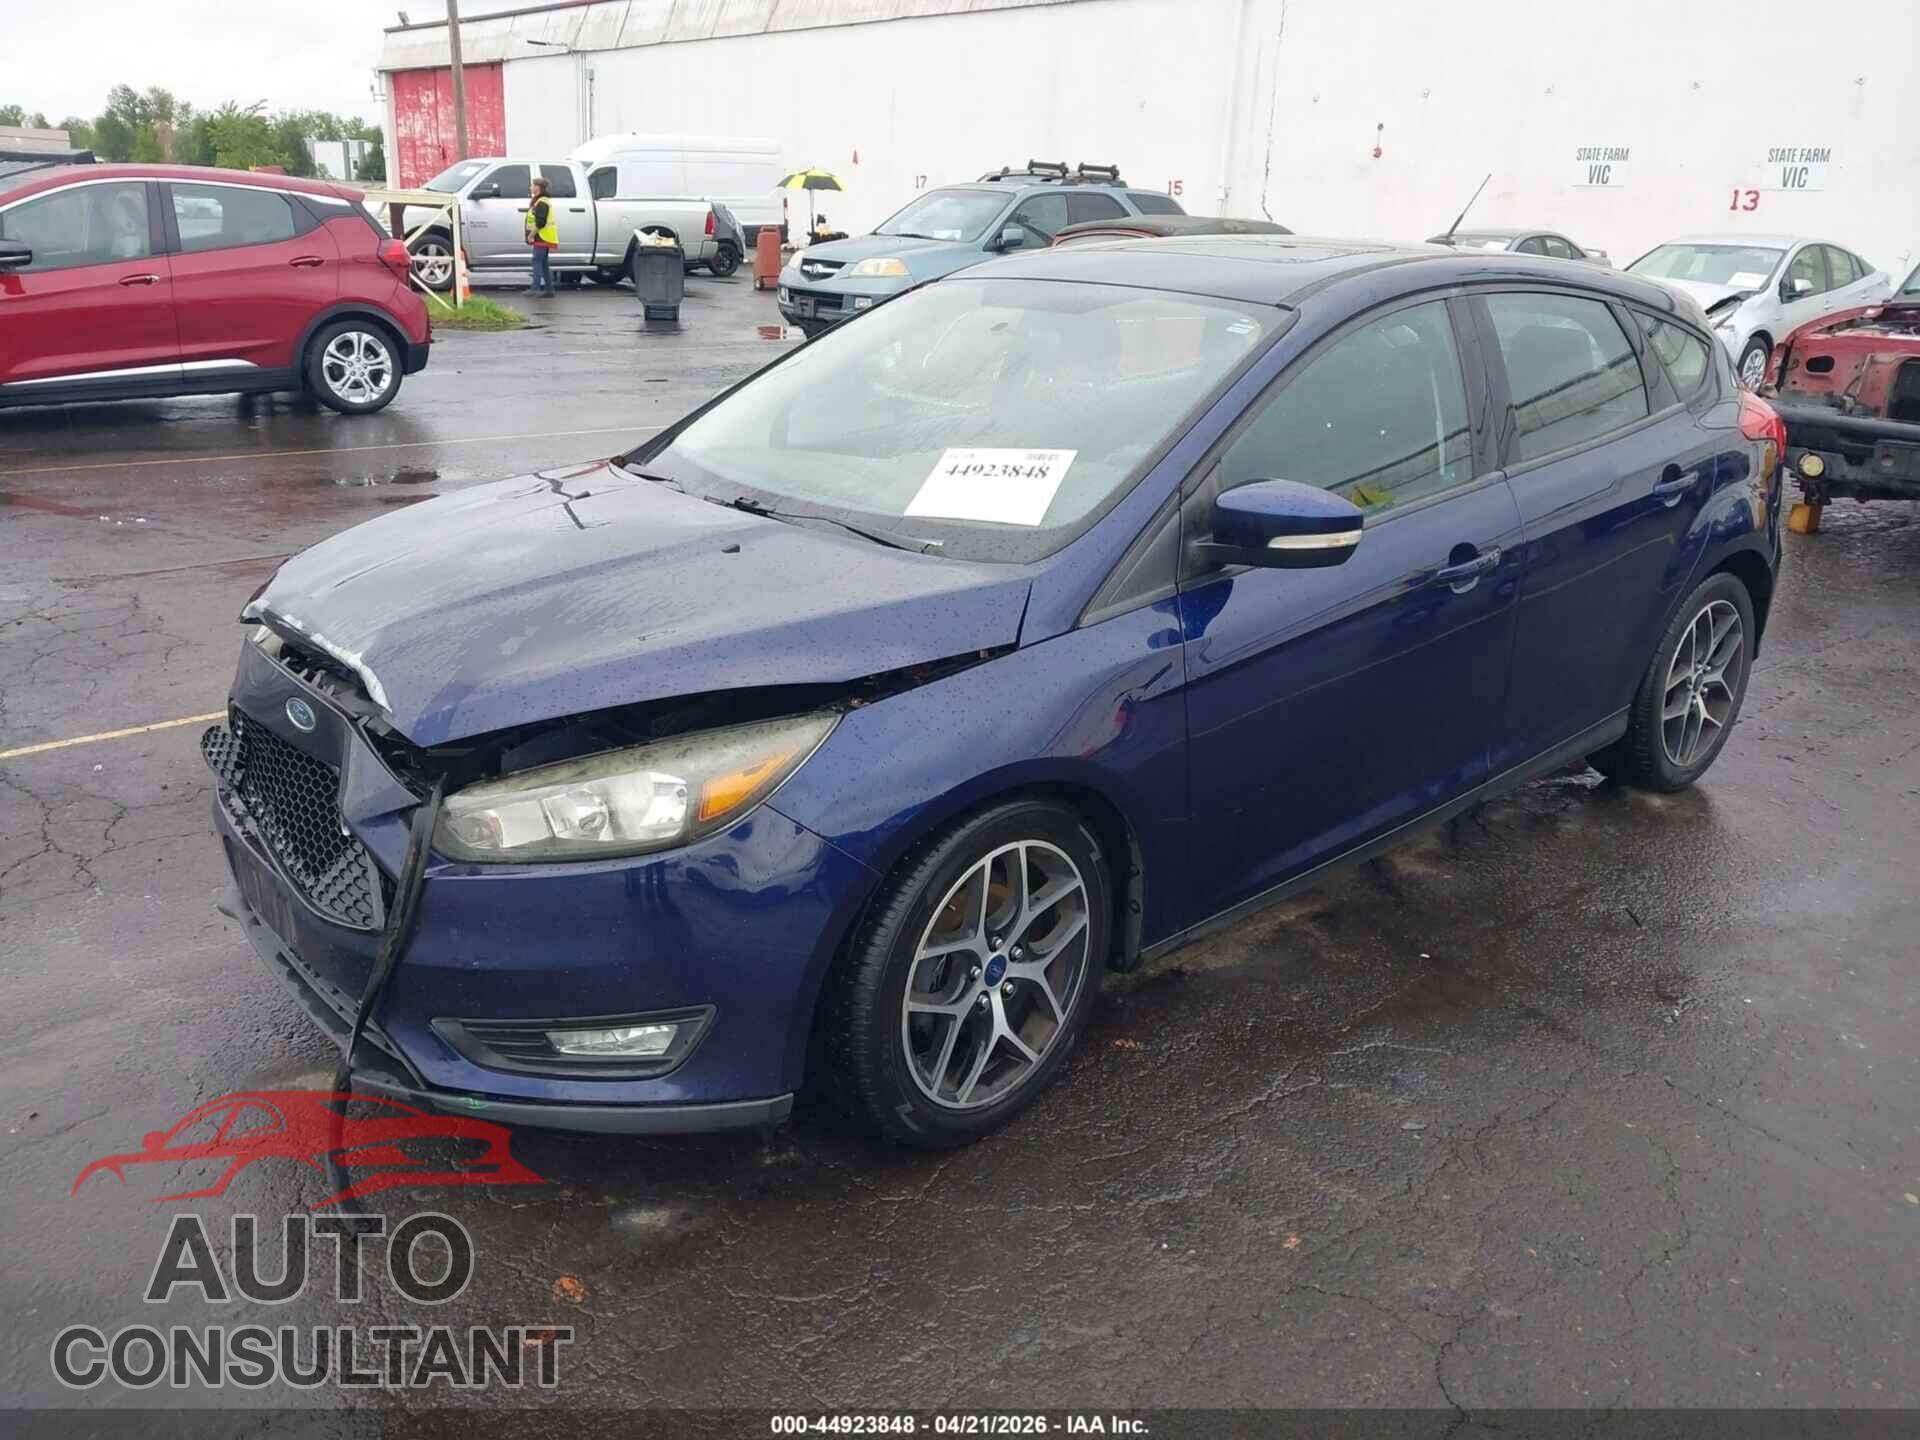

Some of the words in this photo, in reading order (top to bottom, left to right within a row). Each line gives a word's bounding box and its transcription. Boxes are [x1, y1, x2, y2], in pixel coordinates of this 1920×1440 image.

[1577, 147, 1601, 161] STATE
[1602, 147, 1630, 161] FARM
[1768, 148, 1798, 163] STATE
[1799, 148, 1831, 163] FARM
[914, 175, 928, 189] 17
[1588, 164, 1611, 185] VIC
[1782, 166, 1809, 188] VIC
[1167, 180, 1183, 196] 15
[1730, 189, 1760, 211] 13
[945, 463, 1050, 479] 44923848
